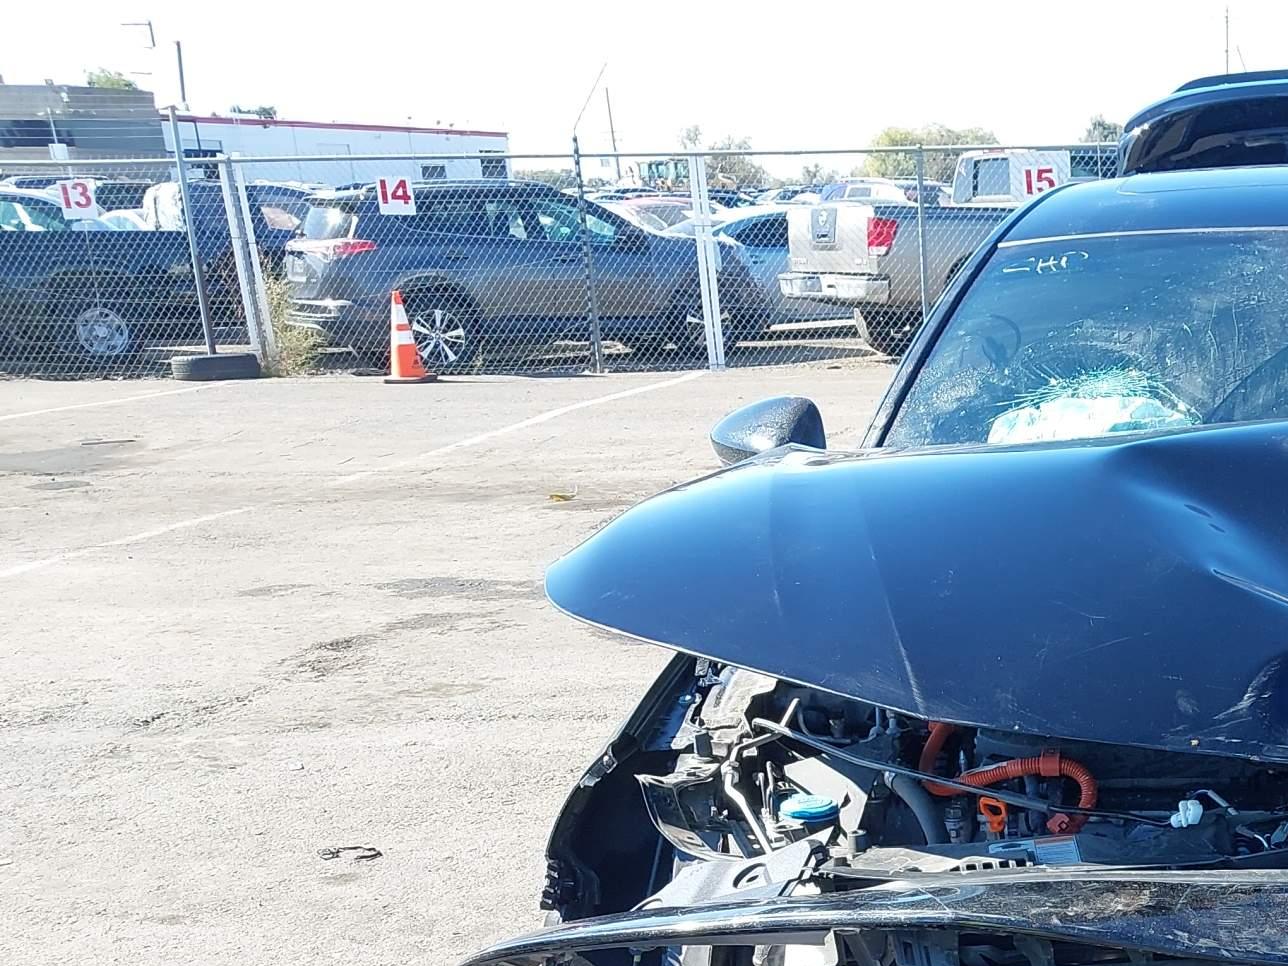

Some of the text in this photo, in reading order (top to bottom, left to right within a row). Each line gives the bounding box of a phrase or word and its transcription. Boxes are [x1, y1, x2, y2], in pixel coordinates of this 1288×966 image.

[379, 179, 411, 205] 14
[1025, 168, 1056, 195] 15
[59, 182, 92, 209] 13
